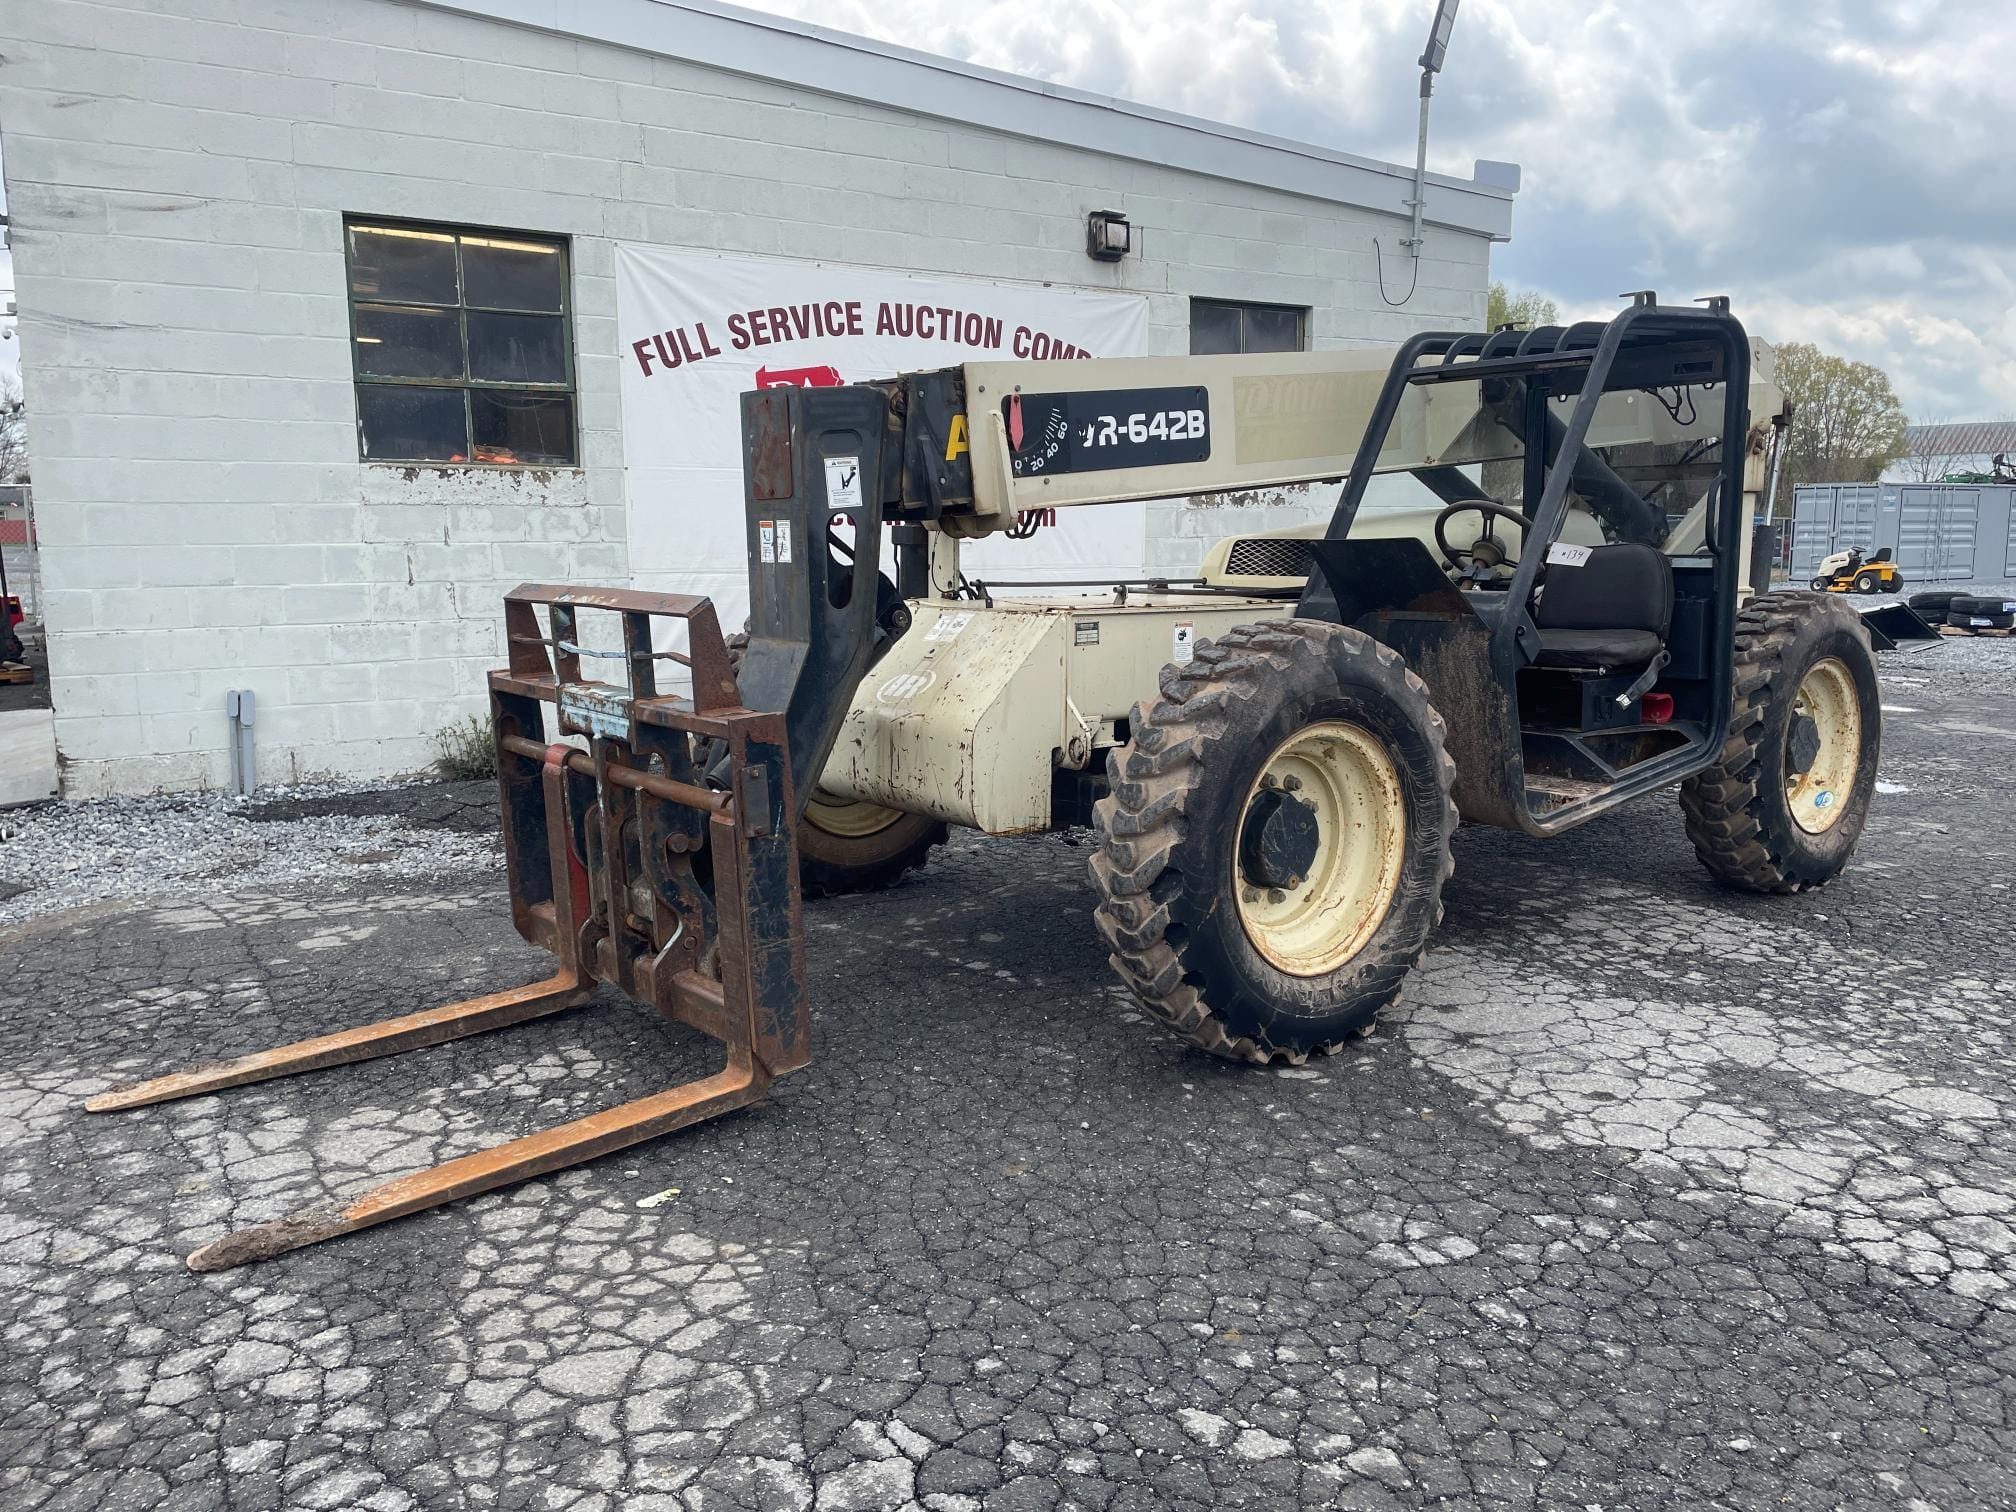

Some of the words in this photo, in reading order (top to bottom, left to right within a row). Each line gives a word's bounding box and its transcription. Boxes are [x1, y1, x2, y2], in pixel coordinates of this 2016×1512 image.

[632, 322, 721, 378] FULL
[728, 301, 864, 350] SERVICE
[876, 302, 1003, 349] AUCTION
[1014, 460, 1023, 470] 0
[1030, 457, 1045, 472] 20
[1046, 442, 1059, 458] 40
[1057, 421, 1068, 440] 60
